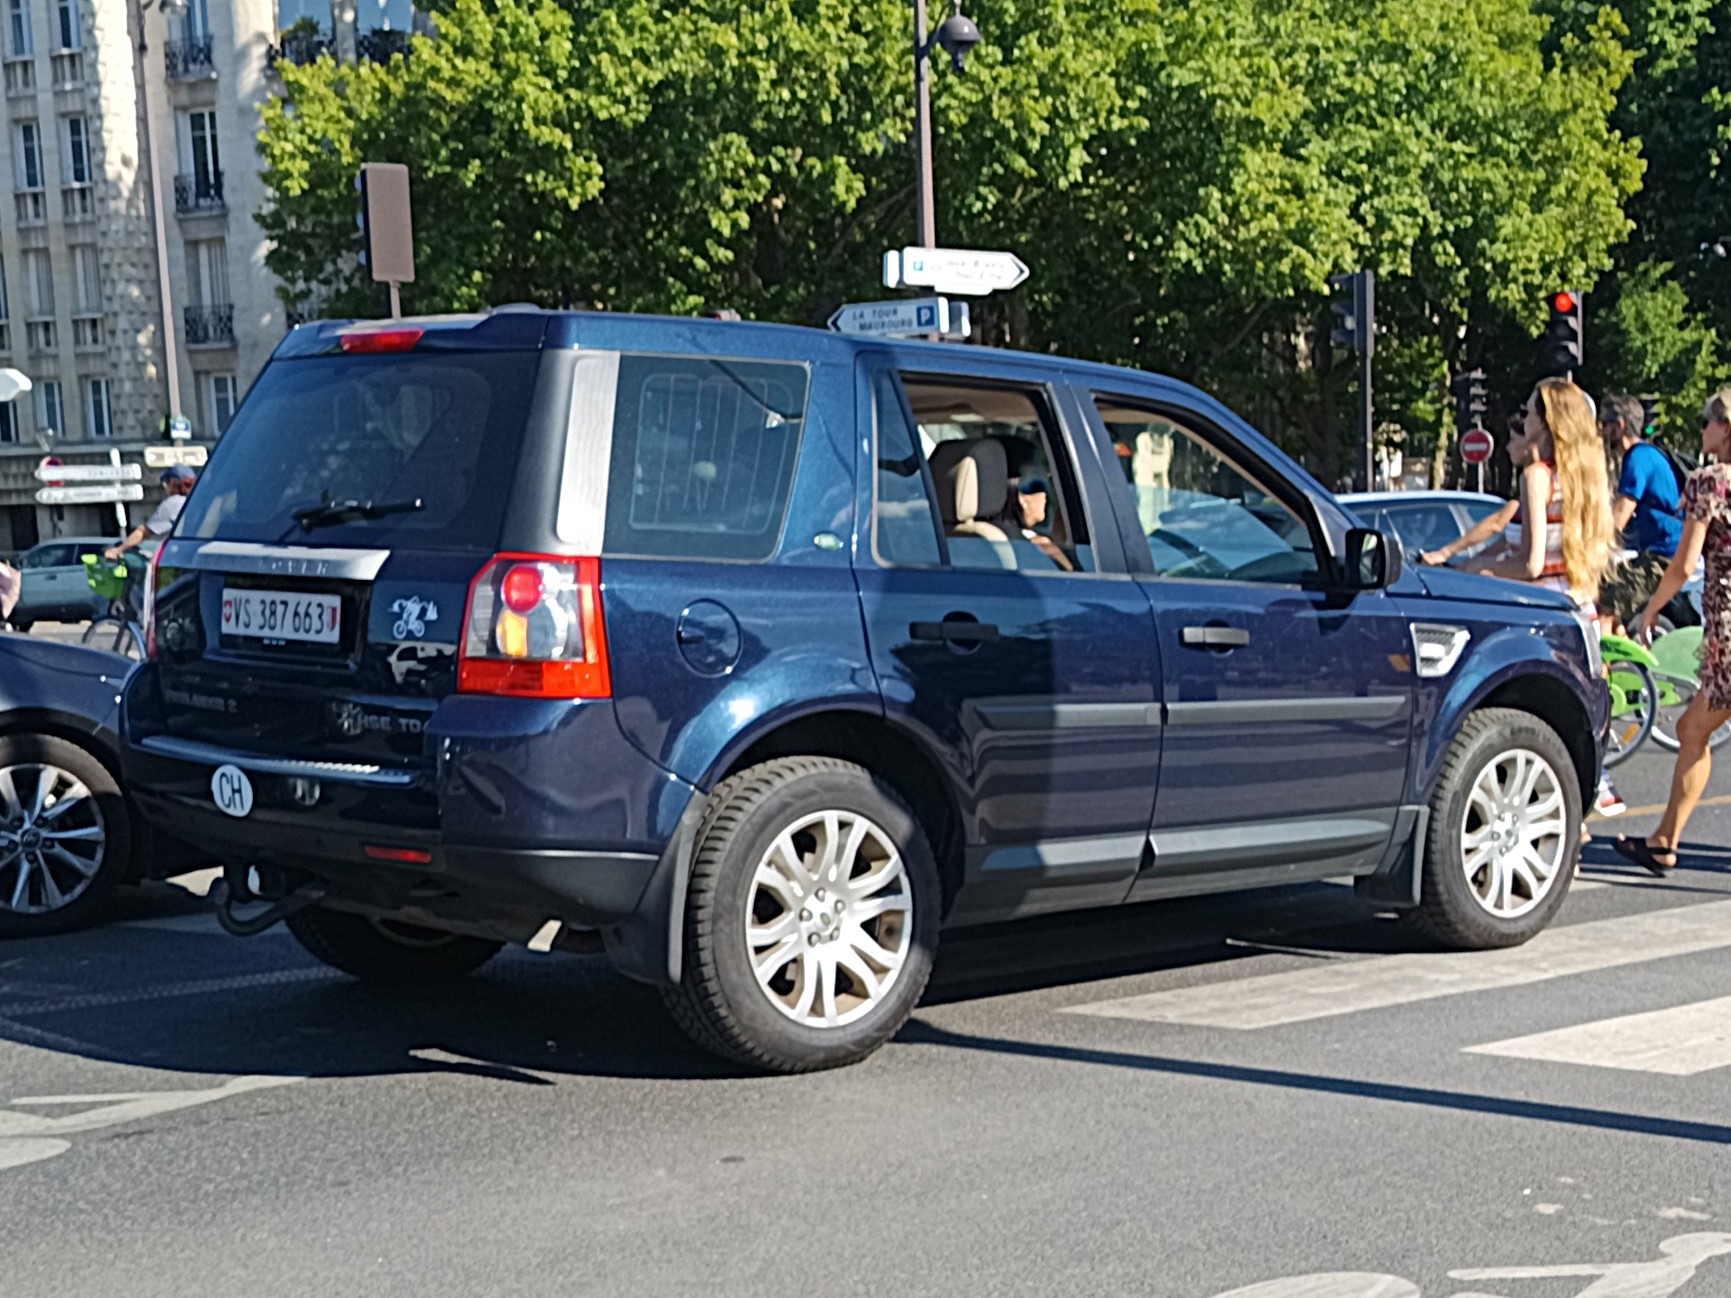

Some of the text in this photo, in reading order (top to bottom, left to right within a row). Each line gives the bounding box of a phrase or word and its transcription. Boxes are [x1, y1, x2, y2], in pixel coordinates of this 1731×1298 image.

[852, 307, 898, 320] LA TOUR
[234, 597, 252, 630] VS
[219, 772, 244, 811] CH
